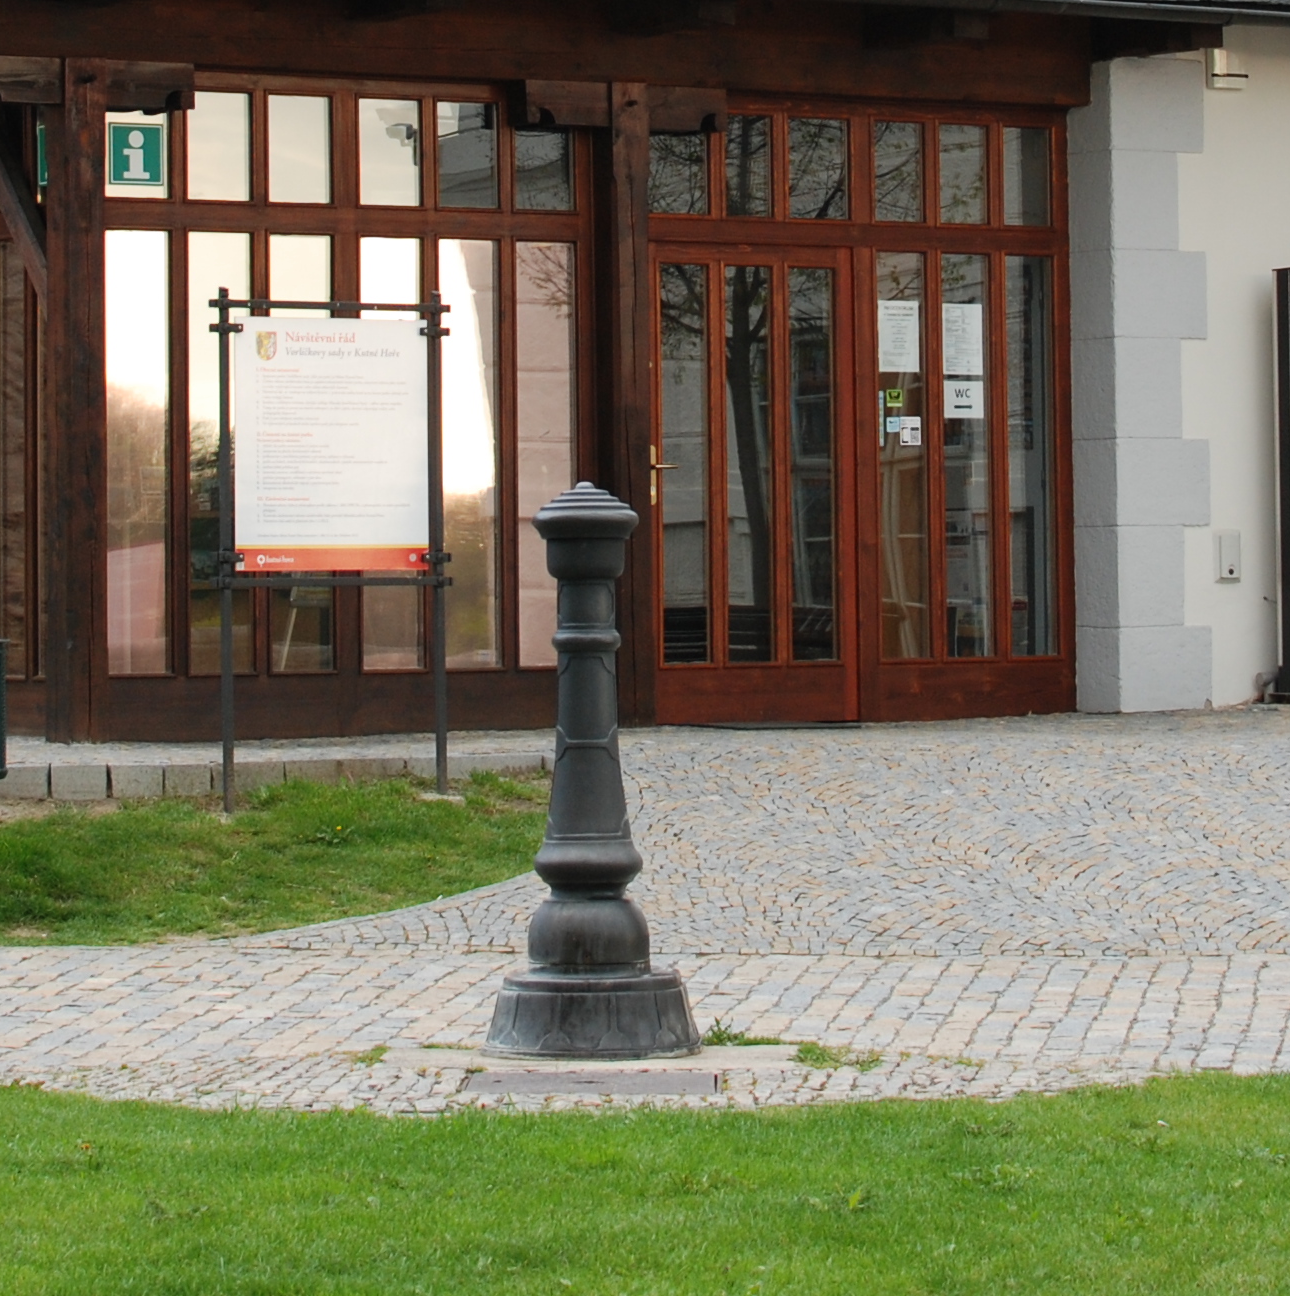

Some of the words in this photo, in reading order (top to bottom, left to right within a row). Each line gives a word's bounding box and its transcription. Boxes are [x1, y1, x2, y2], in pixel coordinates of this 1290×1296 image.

[285, 331, 336, 343] Návštěvní
[338, 332, 356, 343] řád
[955, 388, 971, 398] WC
